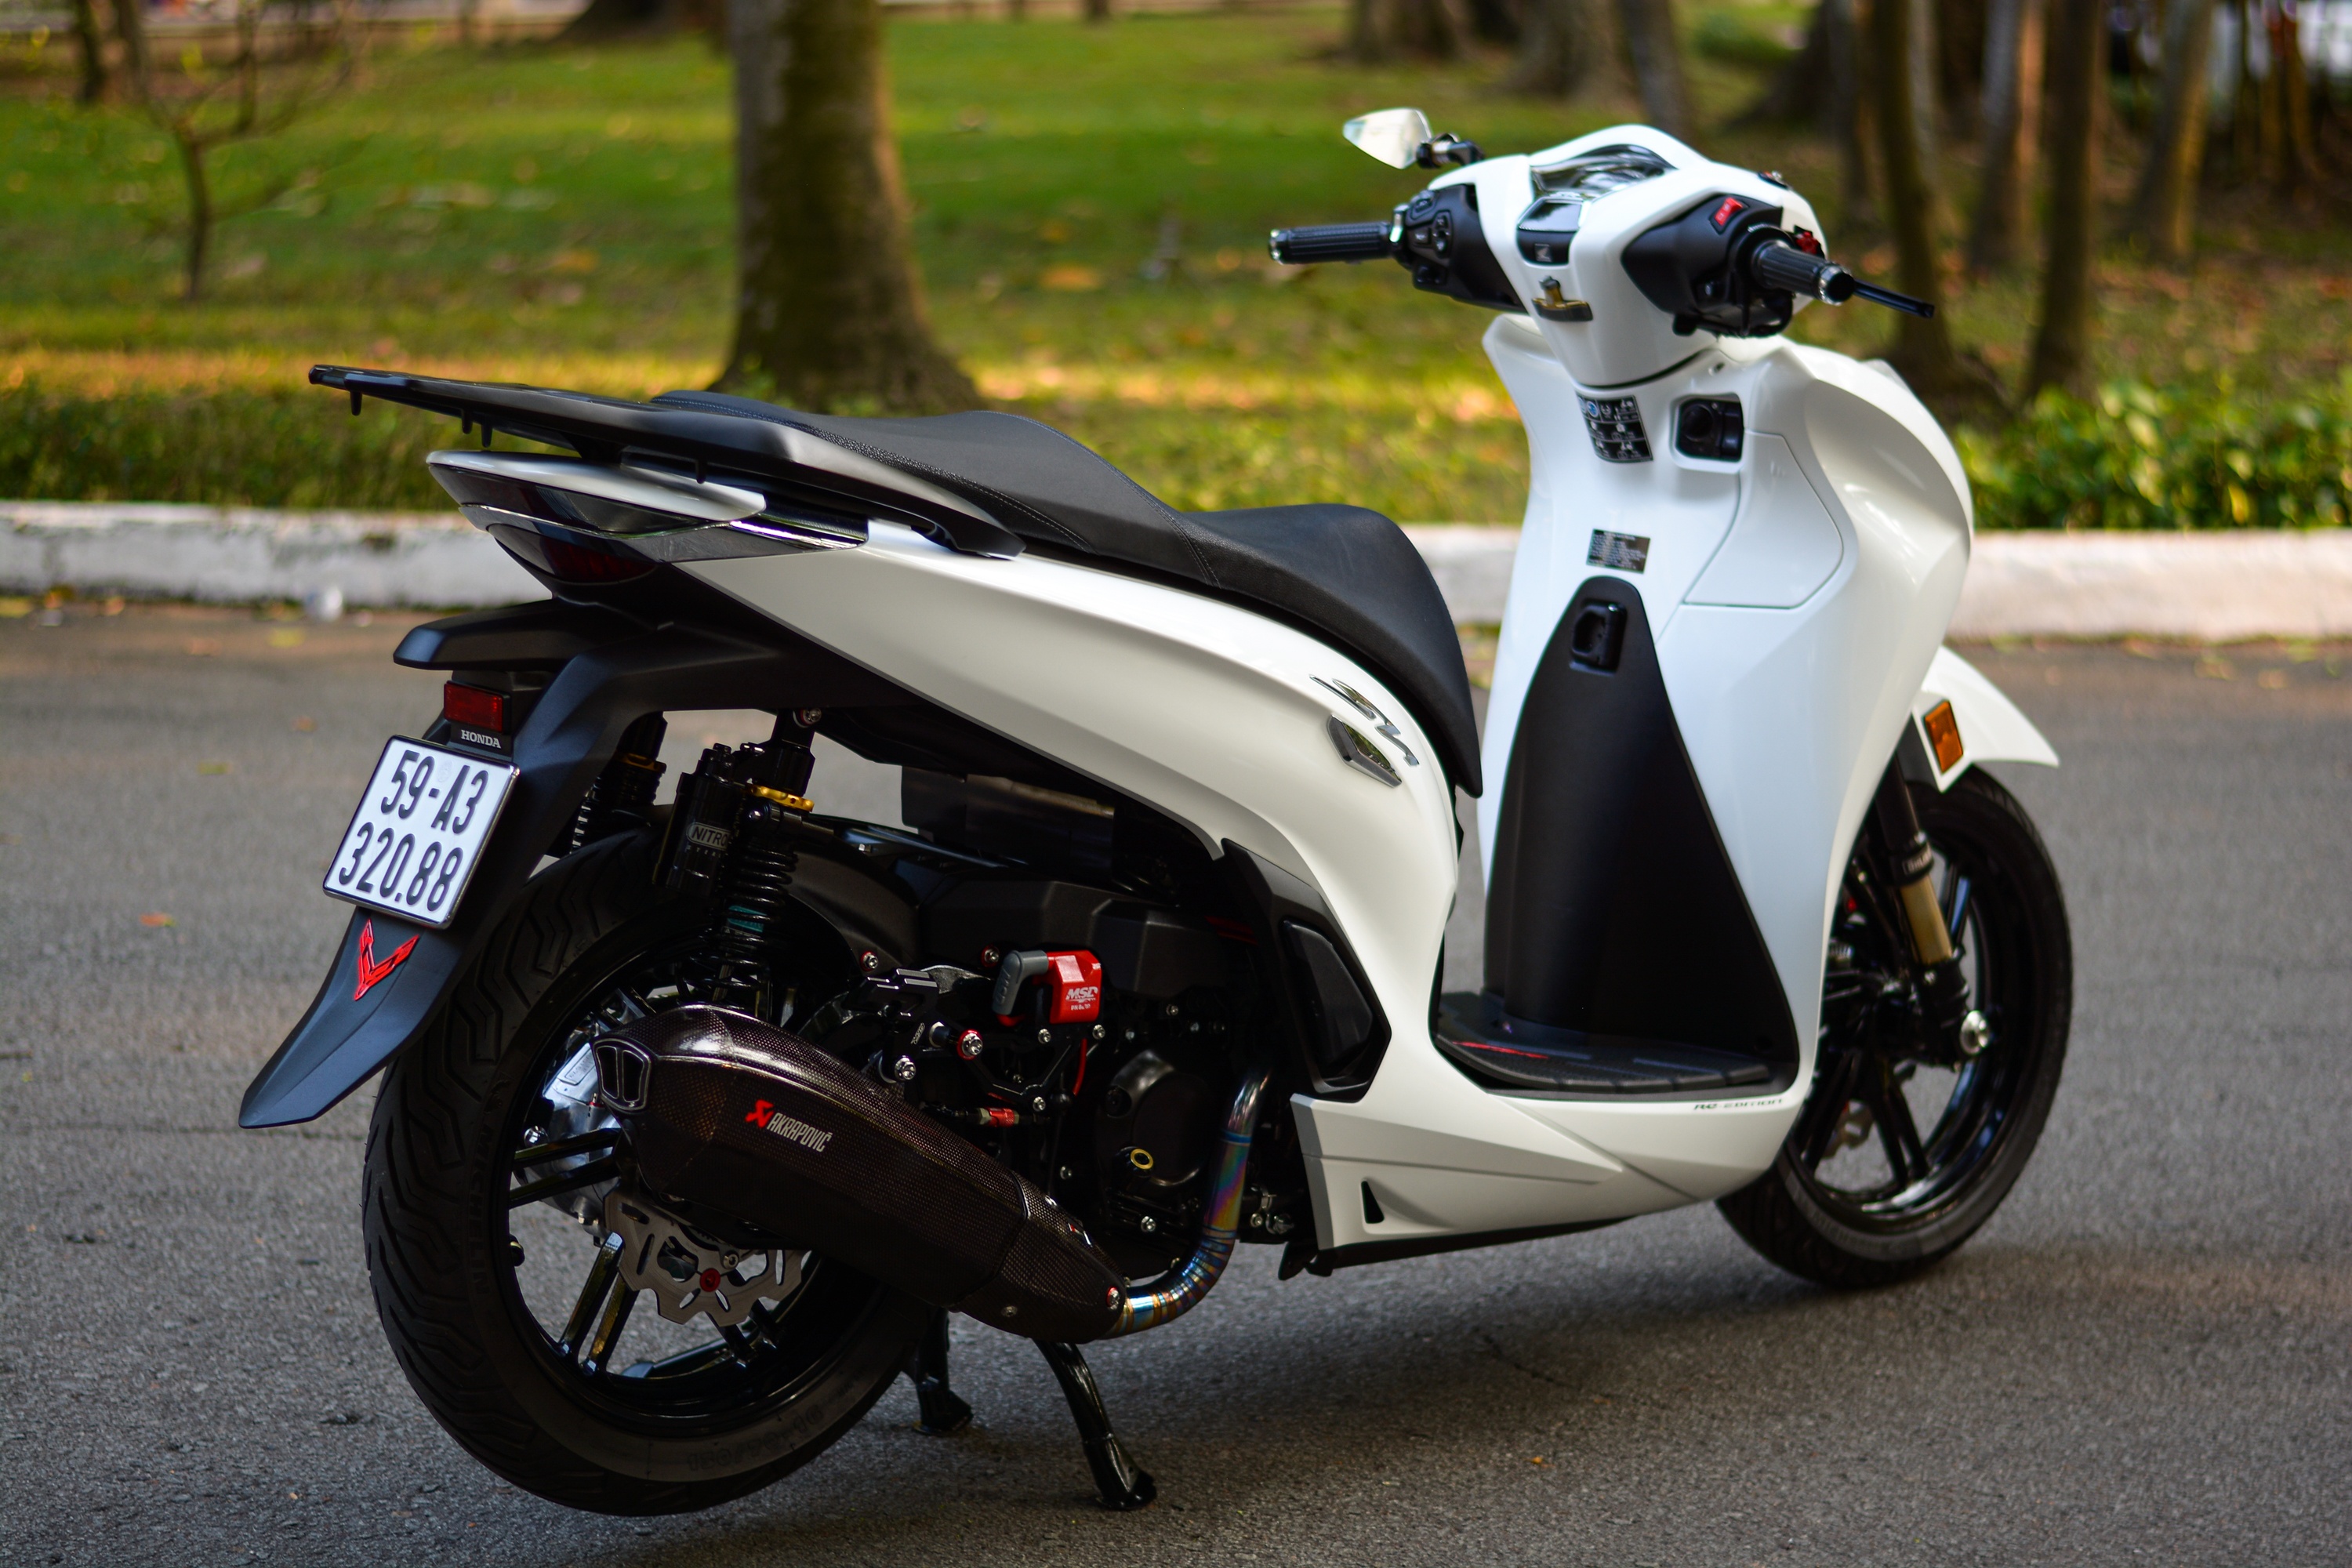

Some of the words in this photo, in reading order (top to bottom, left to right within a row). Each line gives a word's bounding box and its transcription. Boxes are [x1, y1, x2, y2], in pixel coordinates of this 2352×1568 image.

[461, 730, 502, 749] HONDA
[381, 750, 489, 834] 59-A3
[339, 822, 463, 912] 320.88
[1065, 985, 1098, 1001] MSD
